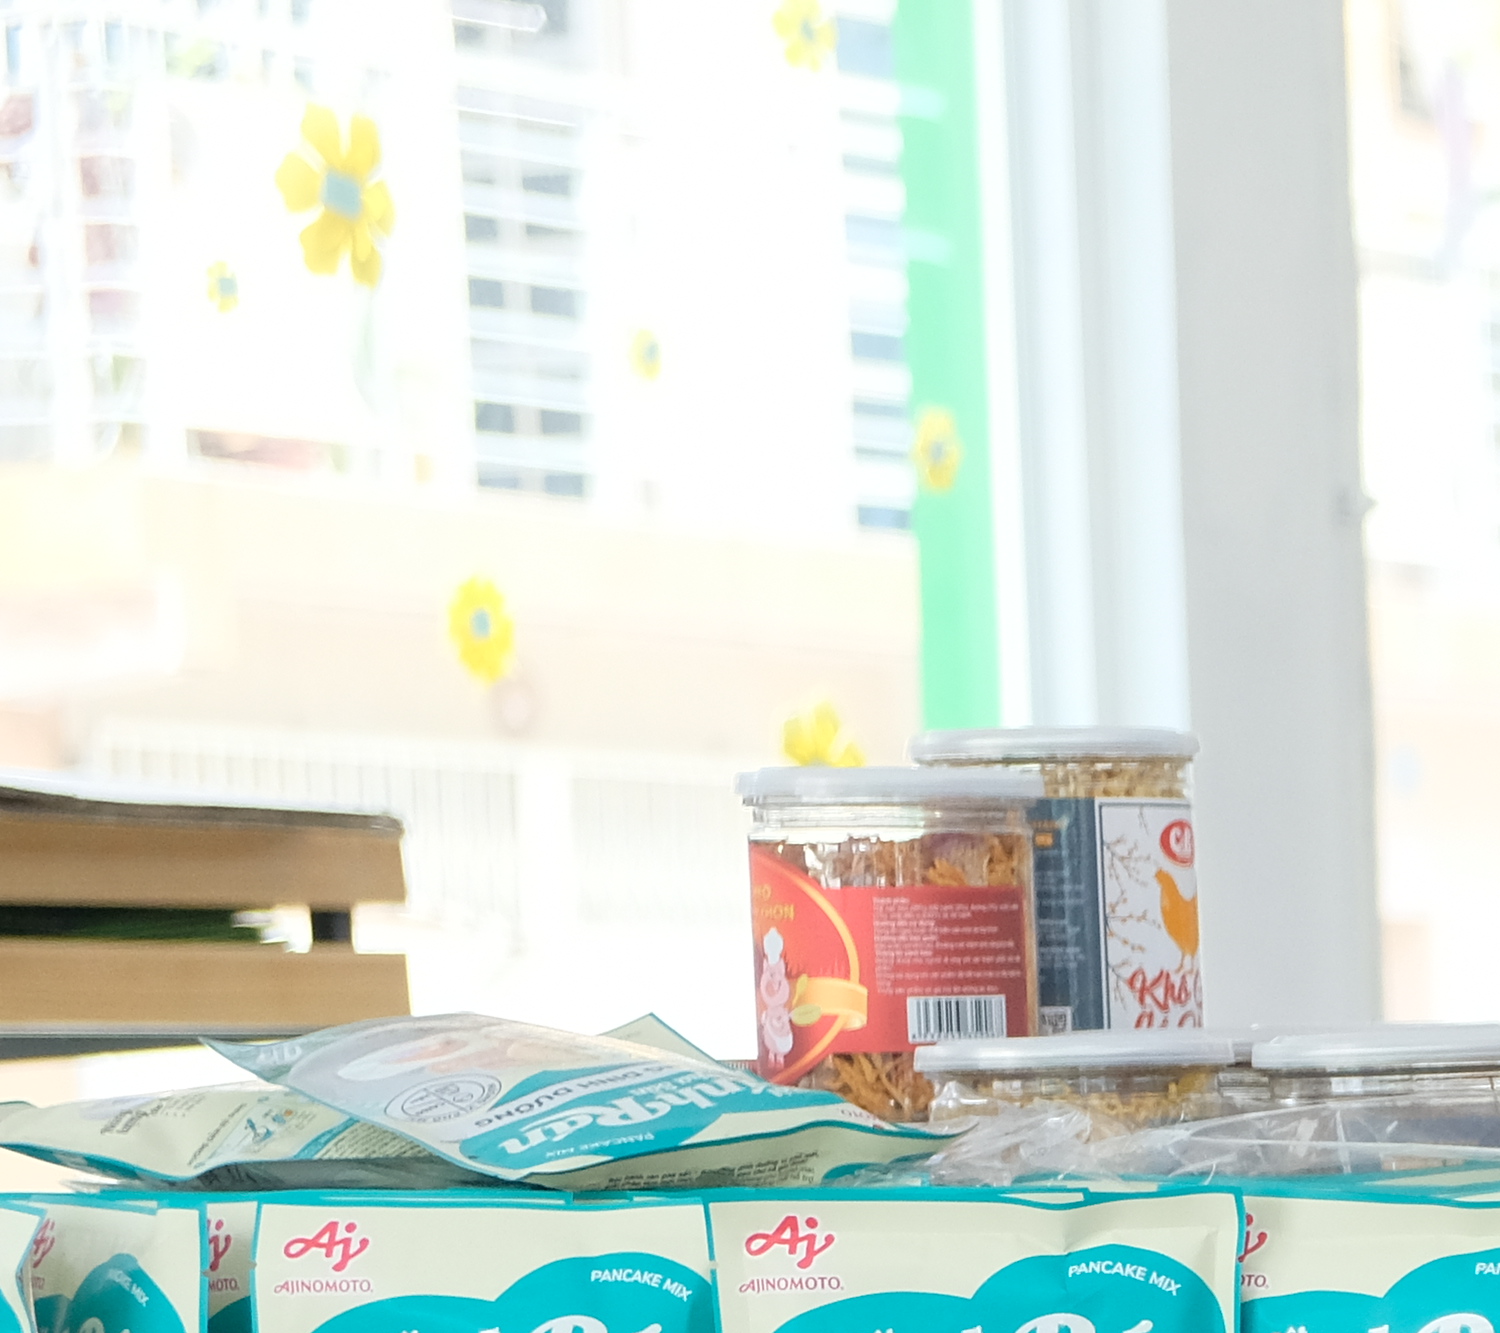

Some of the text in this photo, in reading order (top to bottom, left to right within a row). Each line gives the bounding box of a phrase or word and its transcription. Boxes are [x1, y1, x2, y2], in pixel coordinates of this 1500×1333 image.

[591, 1269, 693, 1301] PANCAKE MIX
[1068, 1261, 1181, 1296] PANCAKE MIX
